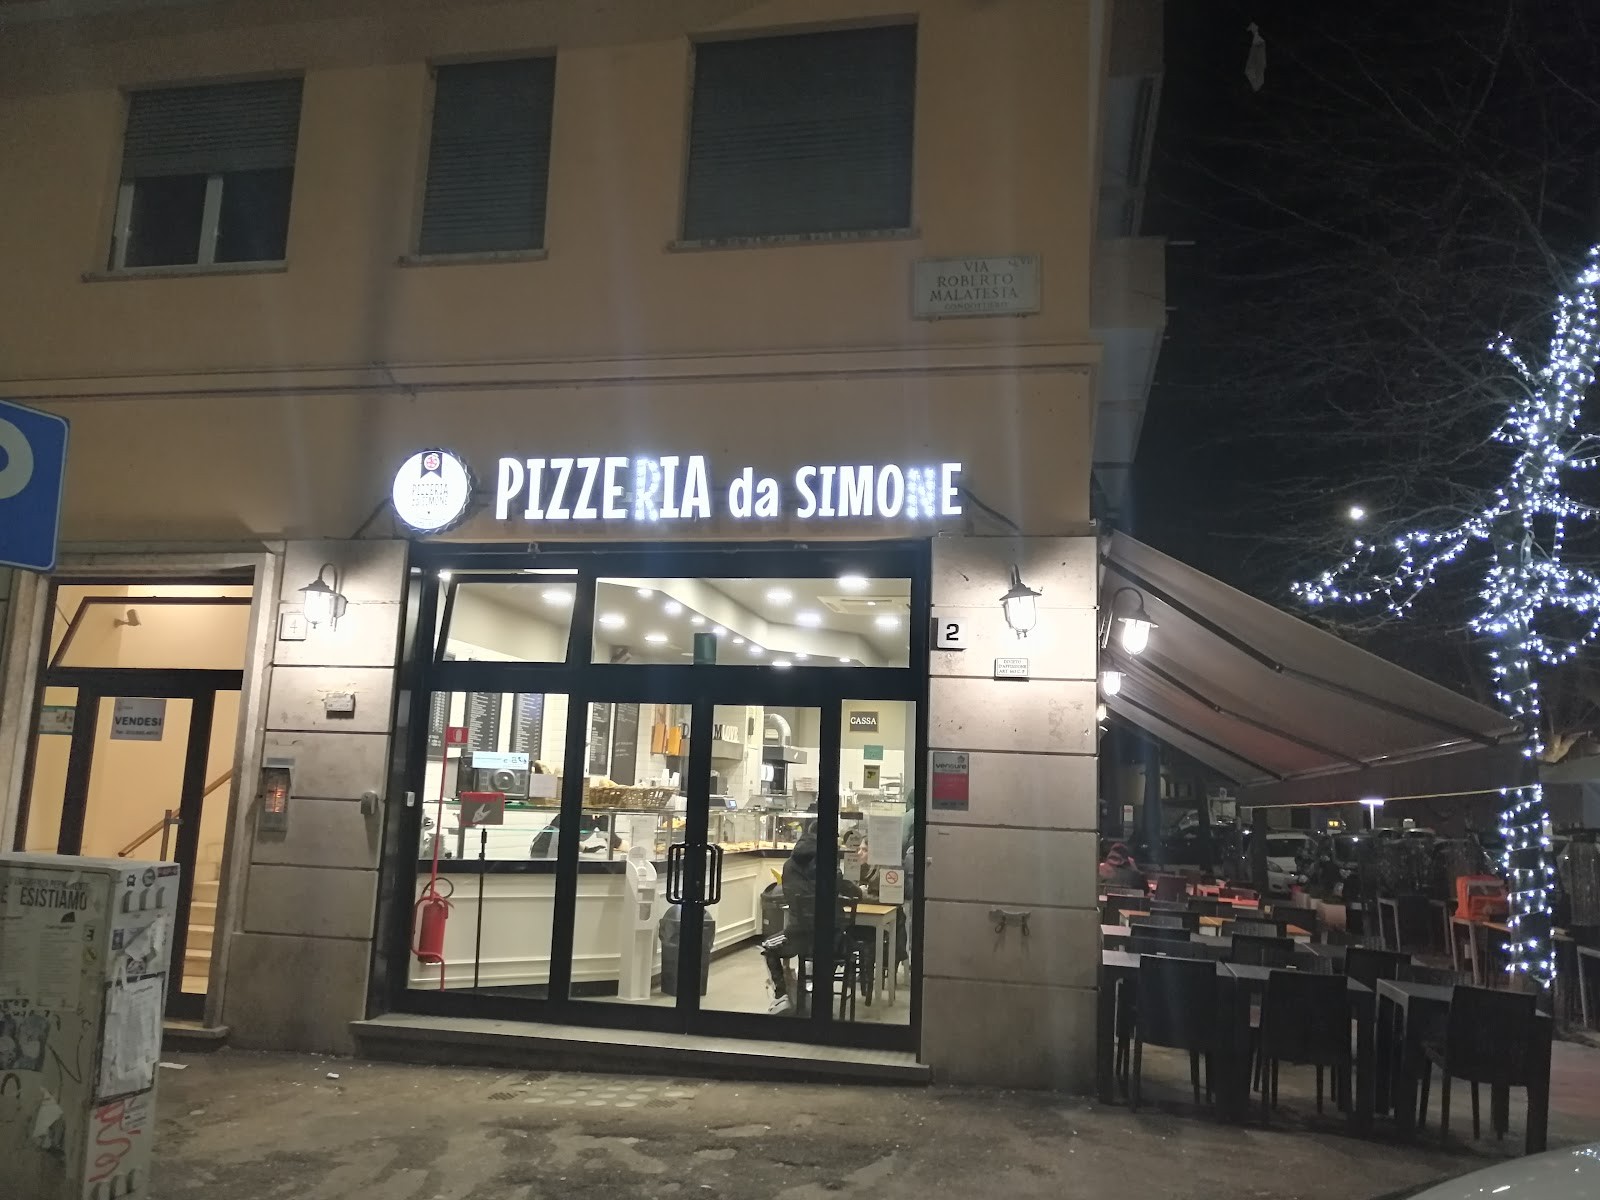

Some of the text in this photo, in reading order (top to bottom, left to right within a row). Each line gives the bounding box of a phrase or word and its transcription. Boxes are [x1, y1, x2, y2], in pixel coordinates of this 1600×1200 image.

[964, 261, 989, 273] VIA
[937, 273, 1014, 288] ROBERTO
[930, 287, 1019, 302] MALATESTA
[495, 455, 963, 521] PIZZERIA da SIMONE
[289, 619, 298, 634] 4
[946, 623, 960, 641] 2
[114, 716, 162, 727] VENDESI
[849, 716, 877, 726] CASSA
[20, 886, 87, 911] ESISTIAMO
